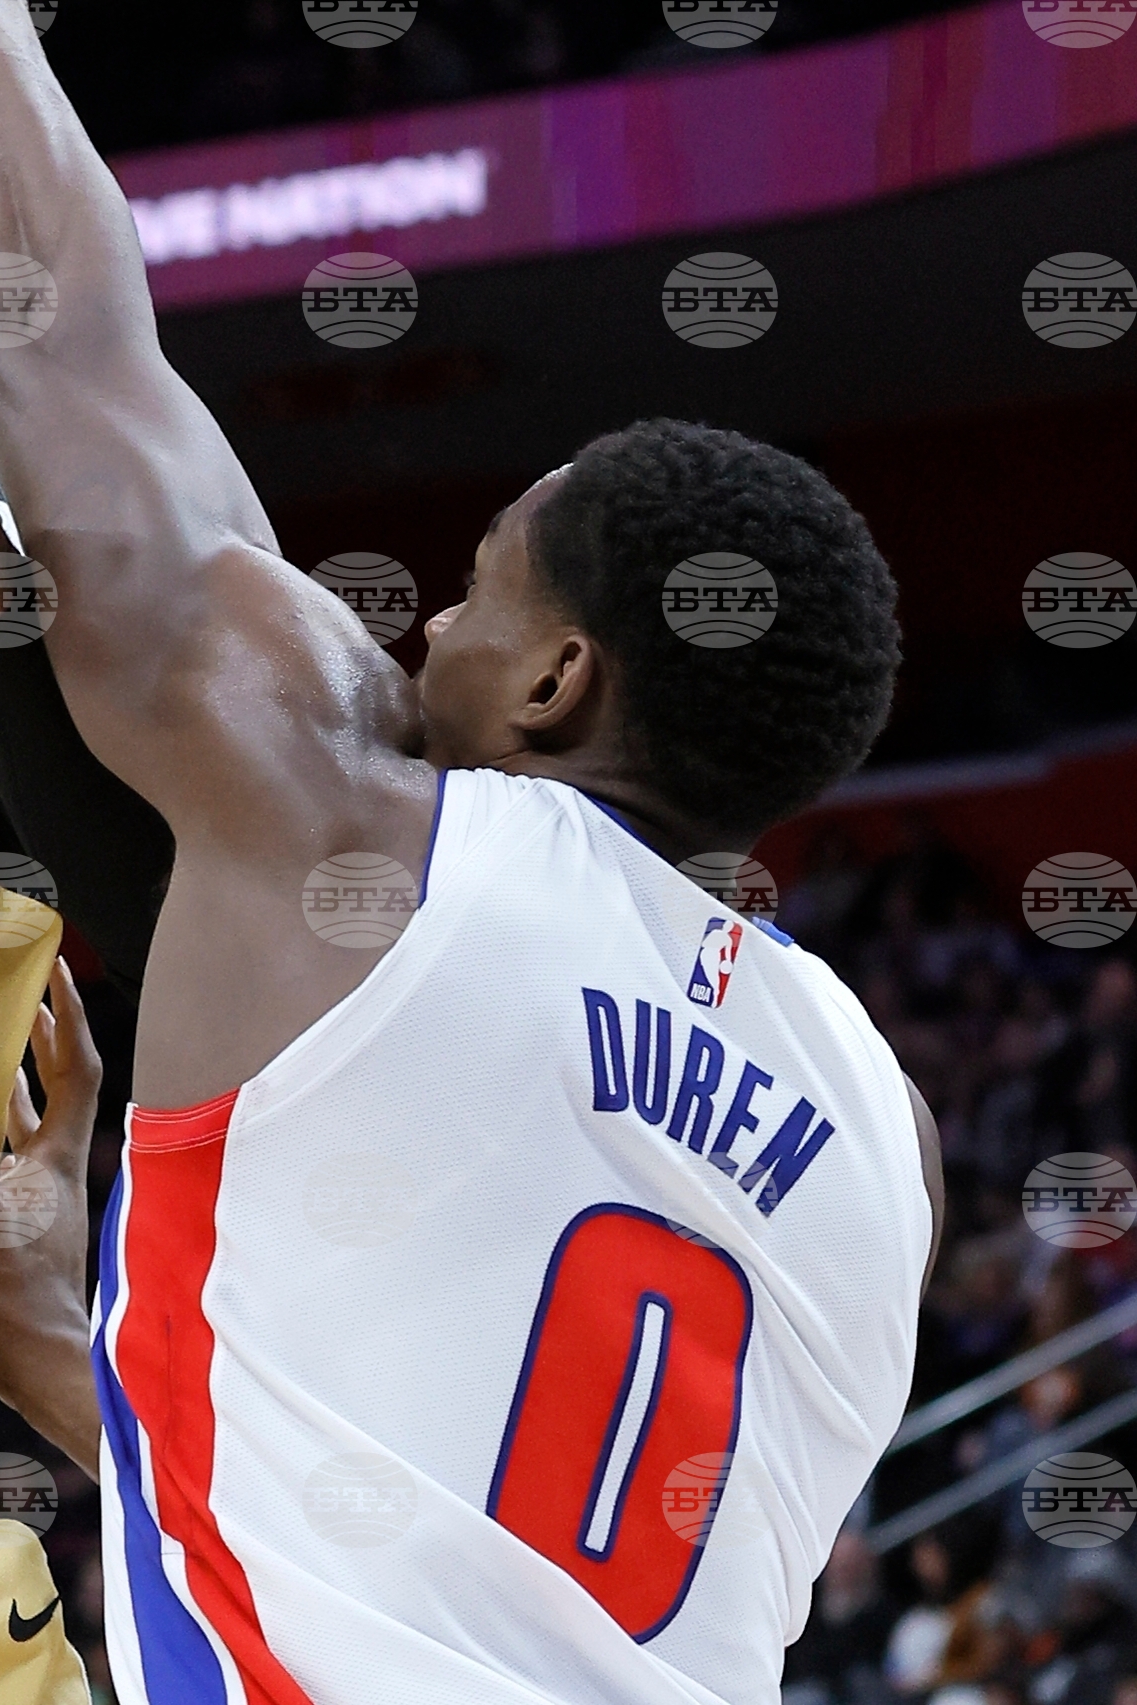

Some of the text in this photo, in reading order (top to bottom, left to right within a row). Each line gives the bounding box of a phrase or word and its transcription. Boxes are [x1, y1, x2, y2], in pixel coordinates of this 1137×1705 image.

[581, 987, 836, 1218] DUREN
[689, 982, 712, 1003] NBA
[486, 1202, 754, 1646] 0
